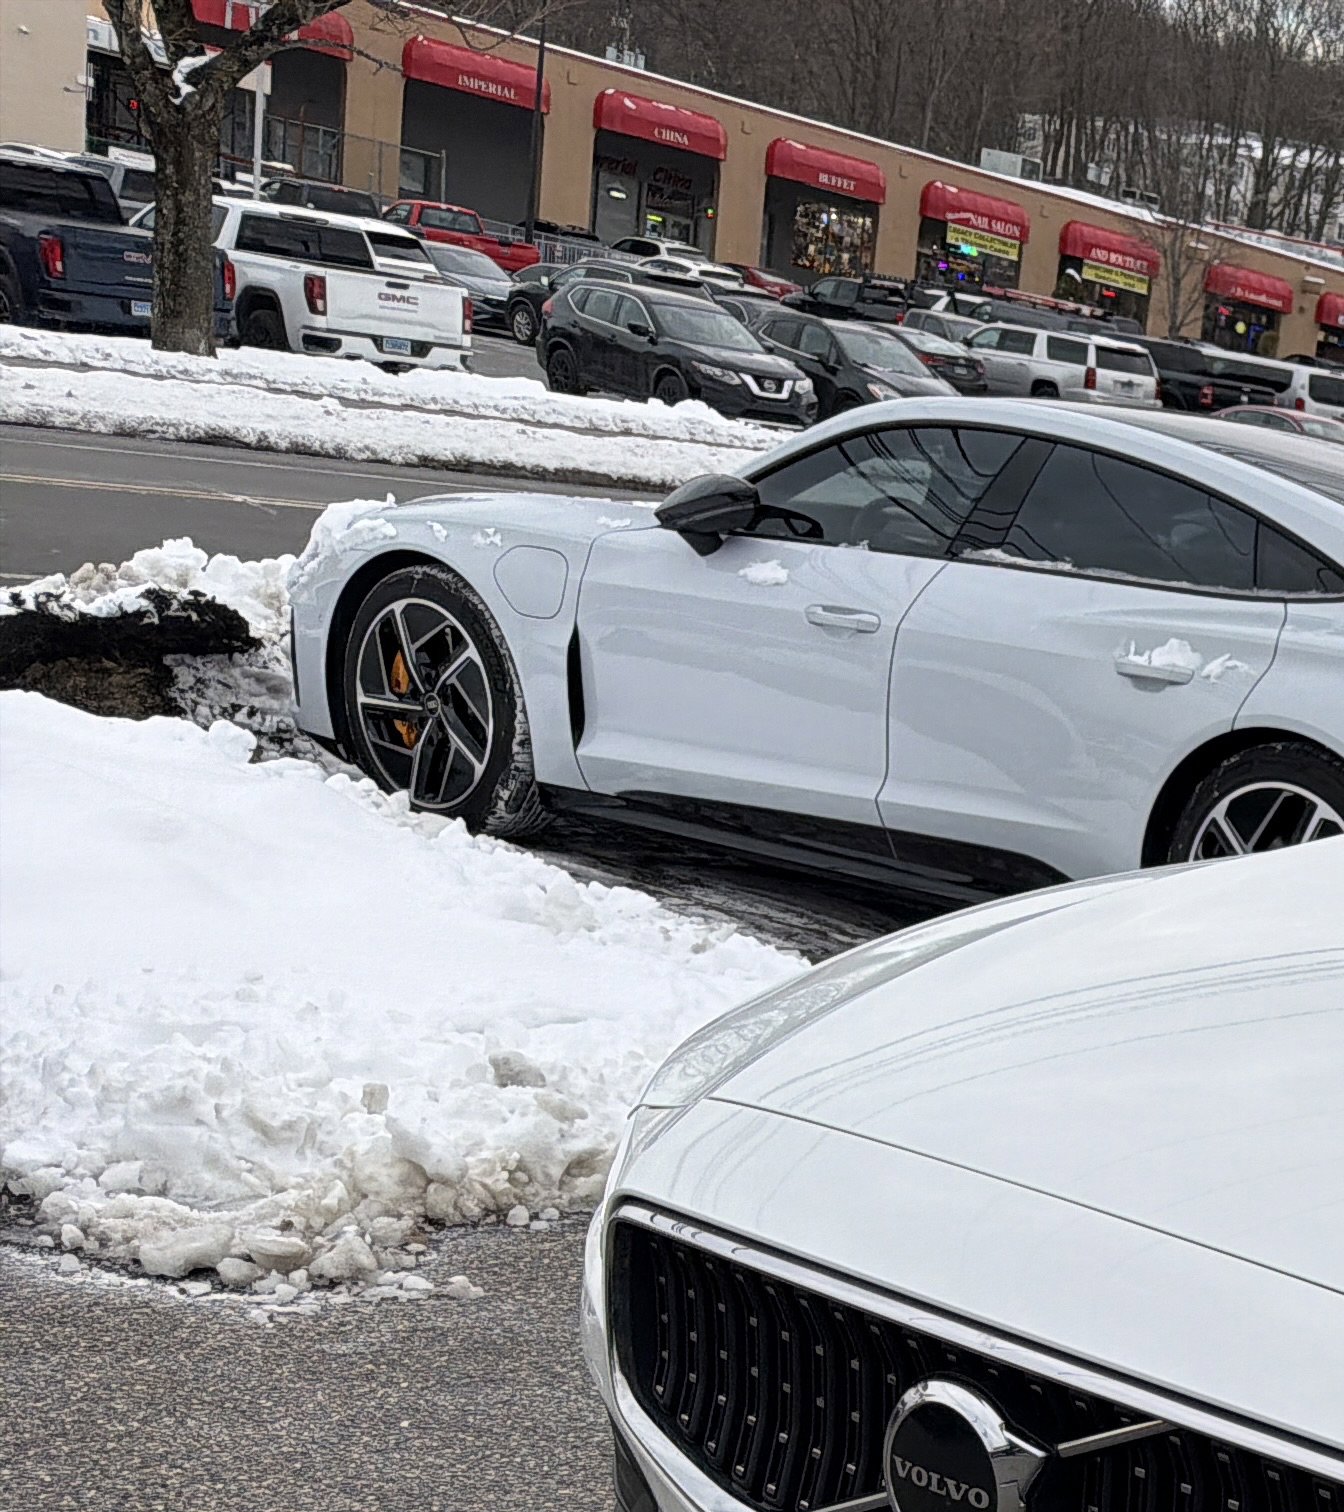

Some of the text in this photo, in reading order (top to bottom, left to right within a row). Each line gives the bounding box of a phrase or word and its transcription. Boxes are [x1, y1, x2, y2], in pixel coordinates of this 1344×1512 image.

[457, 74, 518, 100] IMPERIAL
[653, 126, 690, 146] CHINA
[818, 172, 857, 192] BUFFET
[969, 213, 1021, 239] NAIL SALON
[377, 291, 420, 307] GMC
[891, 1453, 991, 1510] VOLVO
